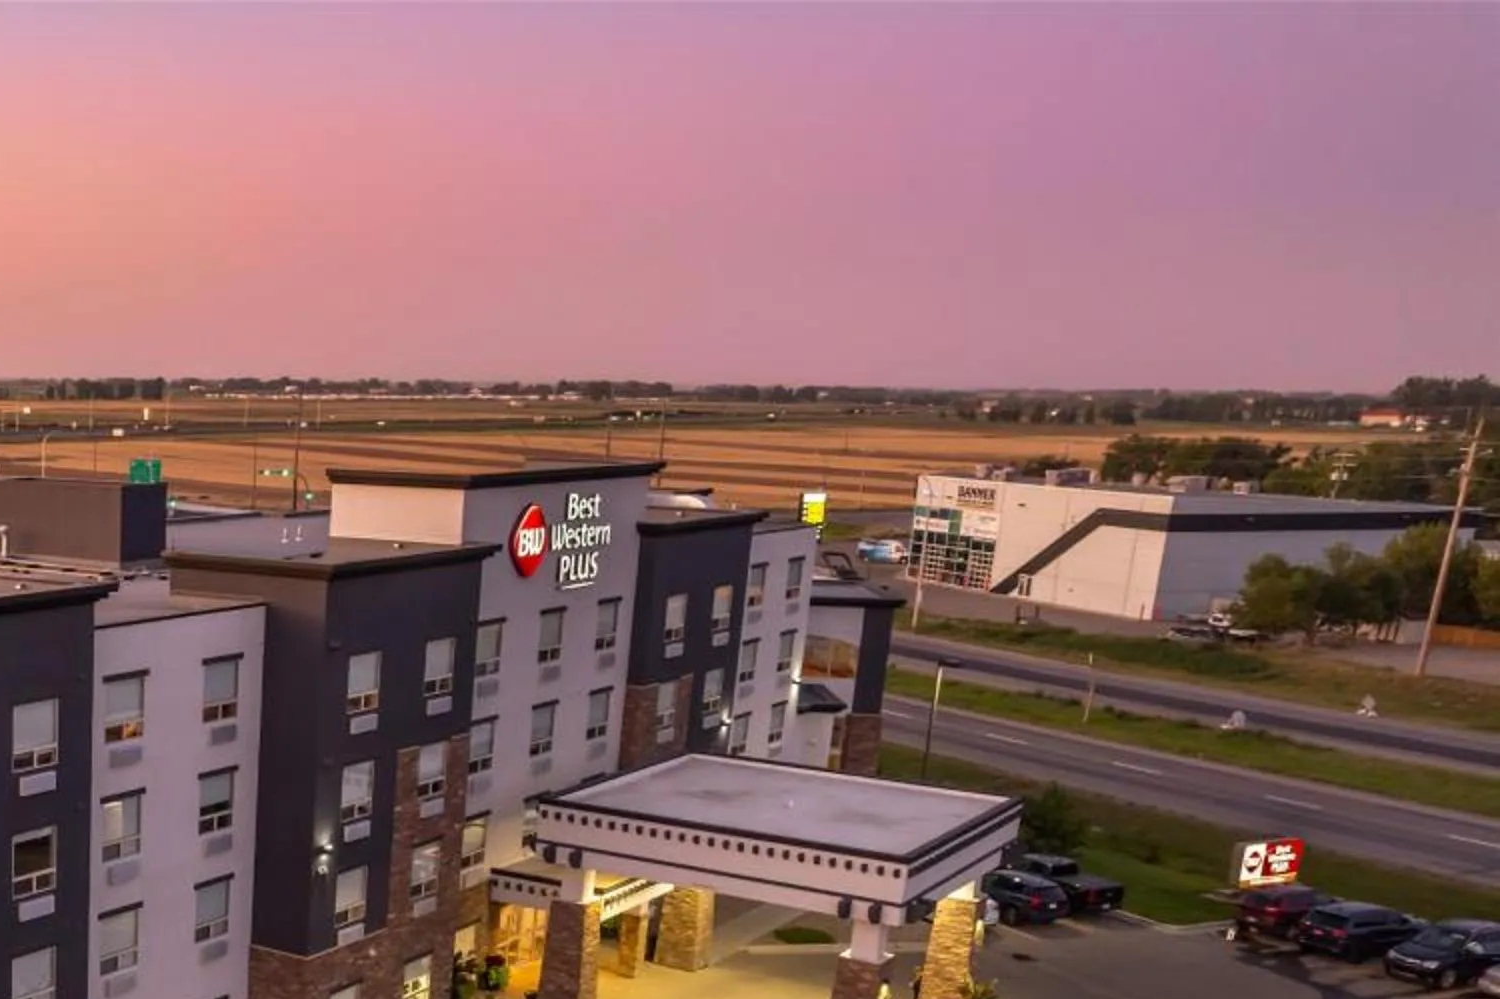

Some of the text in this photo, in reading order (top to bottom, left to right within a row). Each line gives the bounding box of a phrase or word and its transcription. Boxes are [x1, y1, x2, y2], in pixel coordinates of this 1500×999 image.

[567, 493, 601, 520] Best
[517, 527, 546, 558] BW
[551, 523, 611, 551] Western
[560, 551, 599, 582] PLUS
